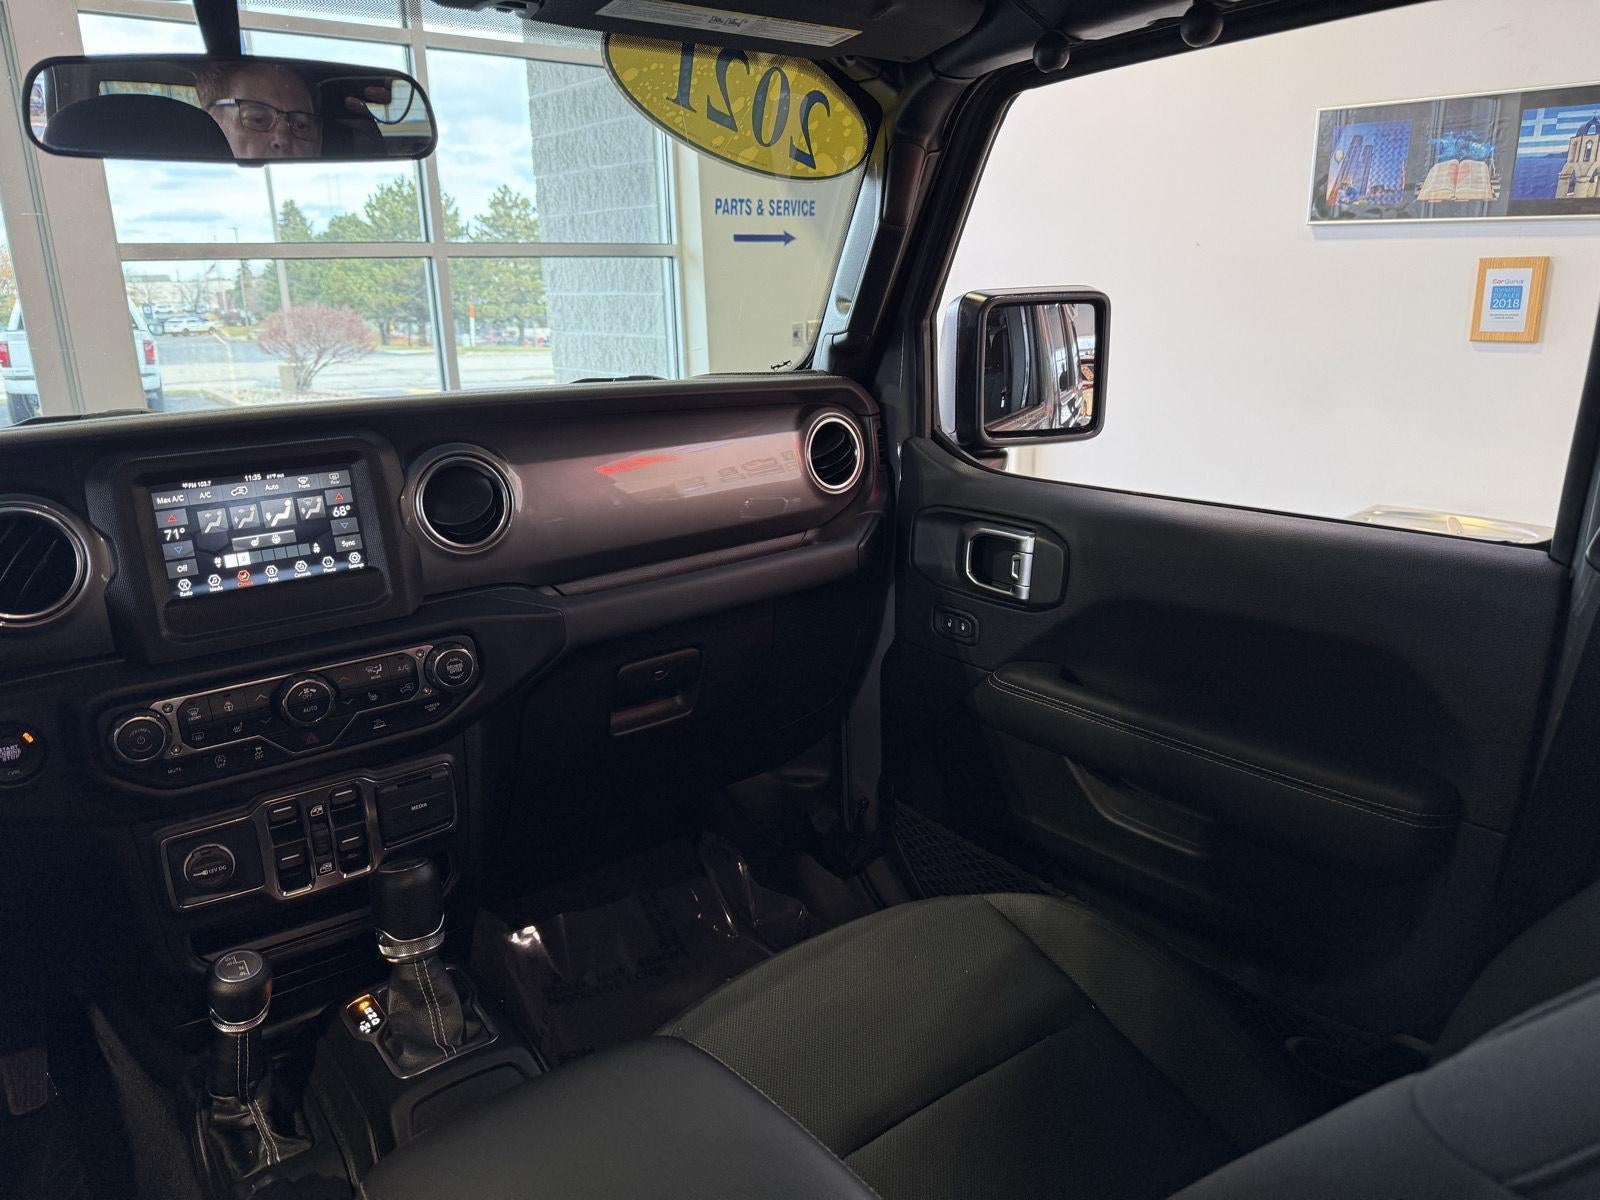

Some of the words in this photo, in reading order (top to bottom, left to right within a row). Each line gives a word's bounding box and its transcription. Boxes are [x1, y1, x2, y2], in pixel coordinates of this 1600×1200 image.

[715, 198, 752, 216] PARTS
[756, 199, 764, 216] &
[769, 199, 816, 217] SERVICE
[1492, 298, 1520, 309] 2018
[244, 473, 262, 482] 11:35
[265, 483, 280, 491] Auto
[156, 496, 171, 505] Max
[171, 494, 185, 503] A/C
[199, 491, 212, 499] A/C
[341, 540, 356, 548] Sync
[177, 564, 188, 573] Off
[303, 705, 319, 713] AUTO
[411, 802, 428, 811] MEDIA
